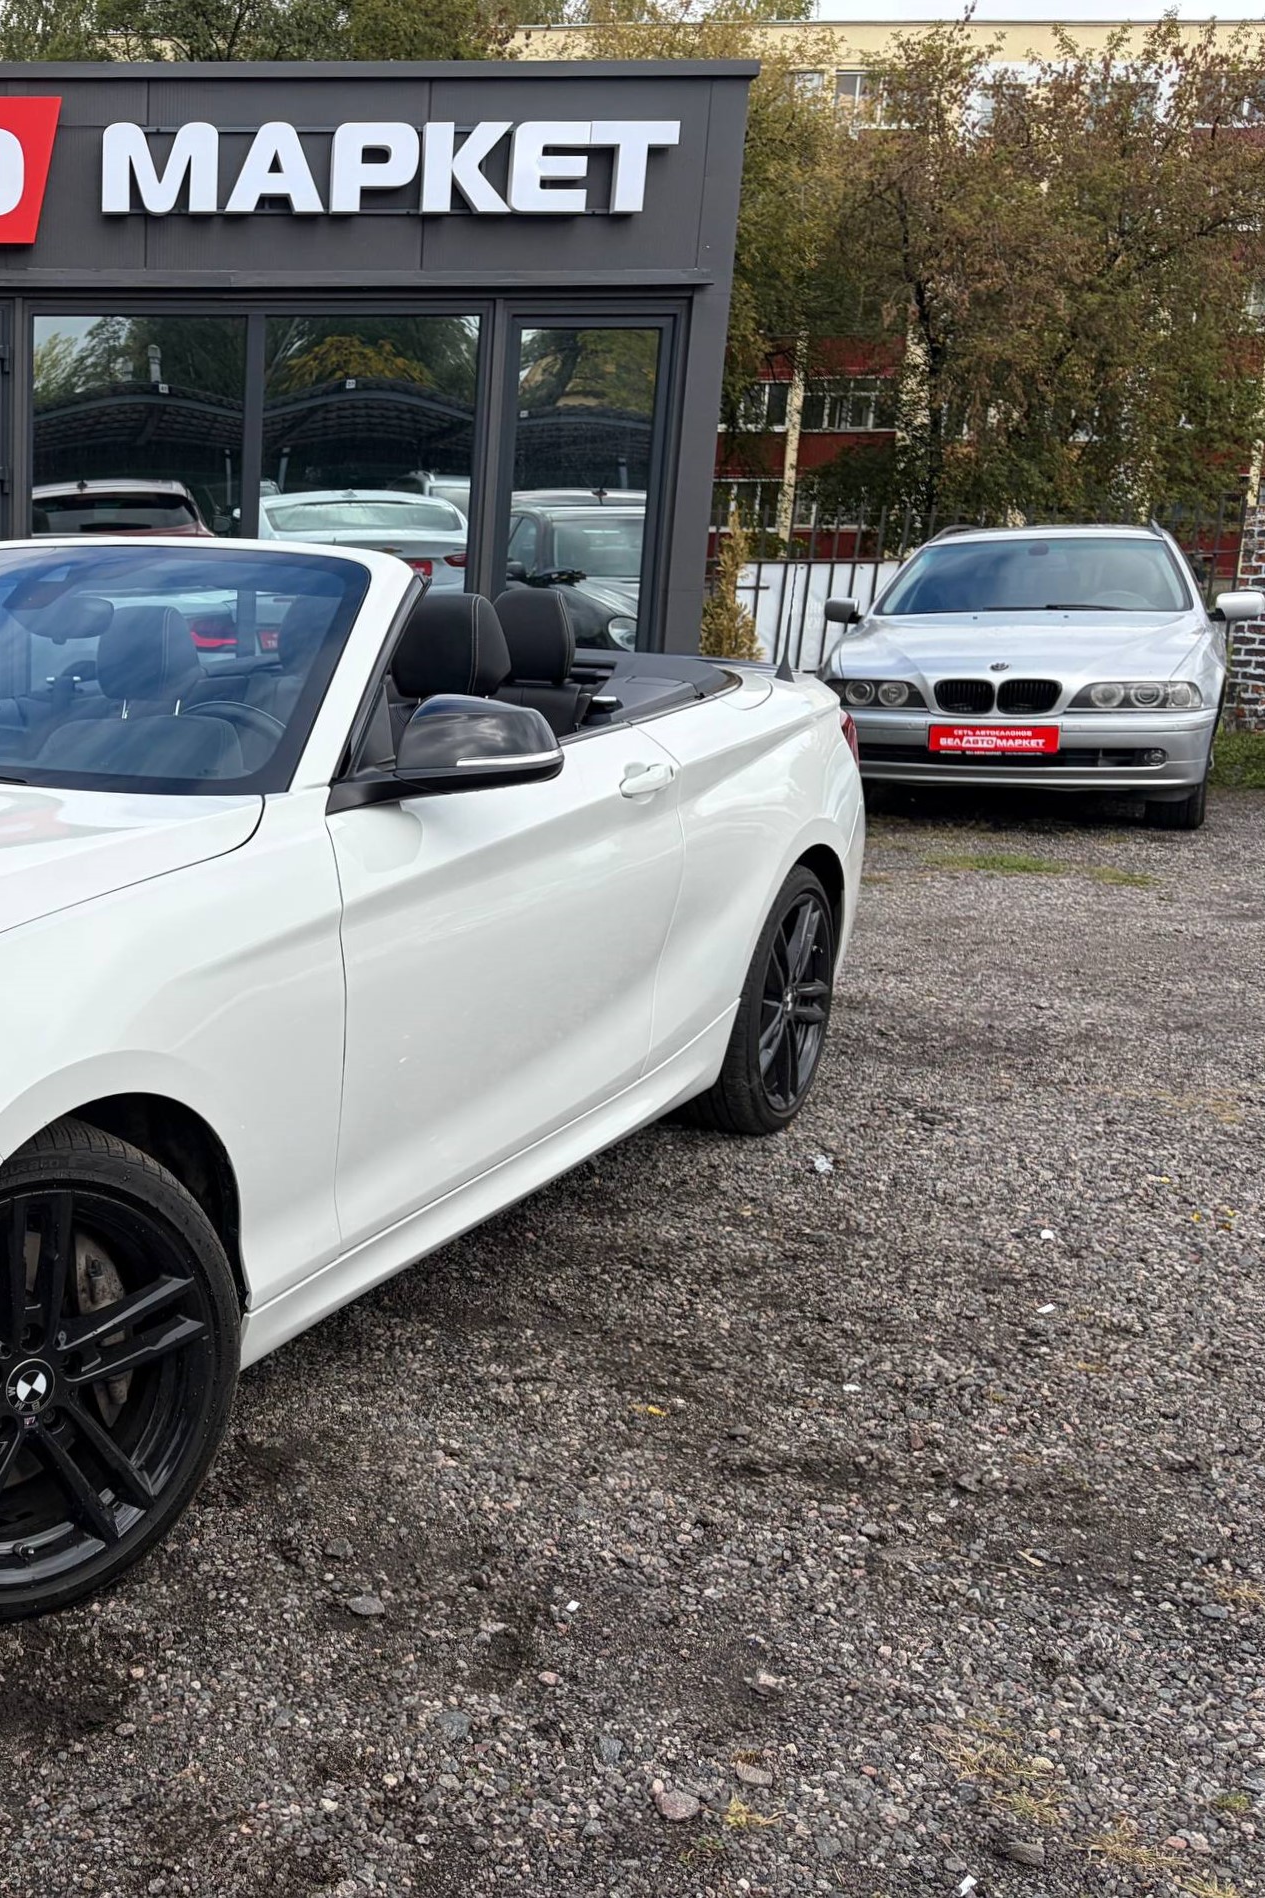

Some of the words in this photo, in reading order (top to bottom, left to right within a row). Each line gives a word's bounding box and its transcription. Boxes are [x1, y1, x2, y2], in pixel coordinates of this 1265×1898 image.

[101, 120, 681, 216] МАРКЕТ
[975, 729, 1032, 737] АВТОСАЛОНОВ
[939, 737, 962, 746] БЕЛ
[964, 737, 995, 747] АВТО
[996, 738, 1045, 748] МАРКЕТ
